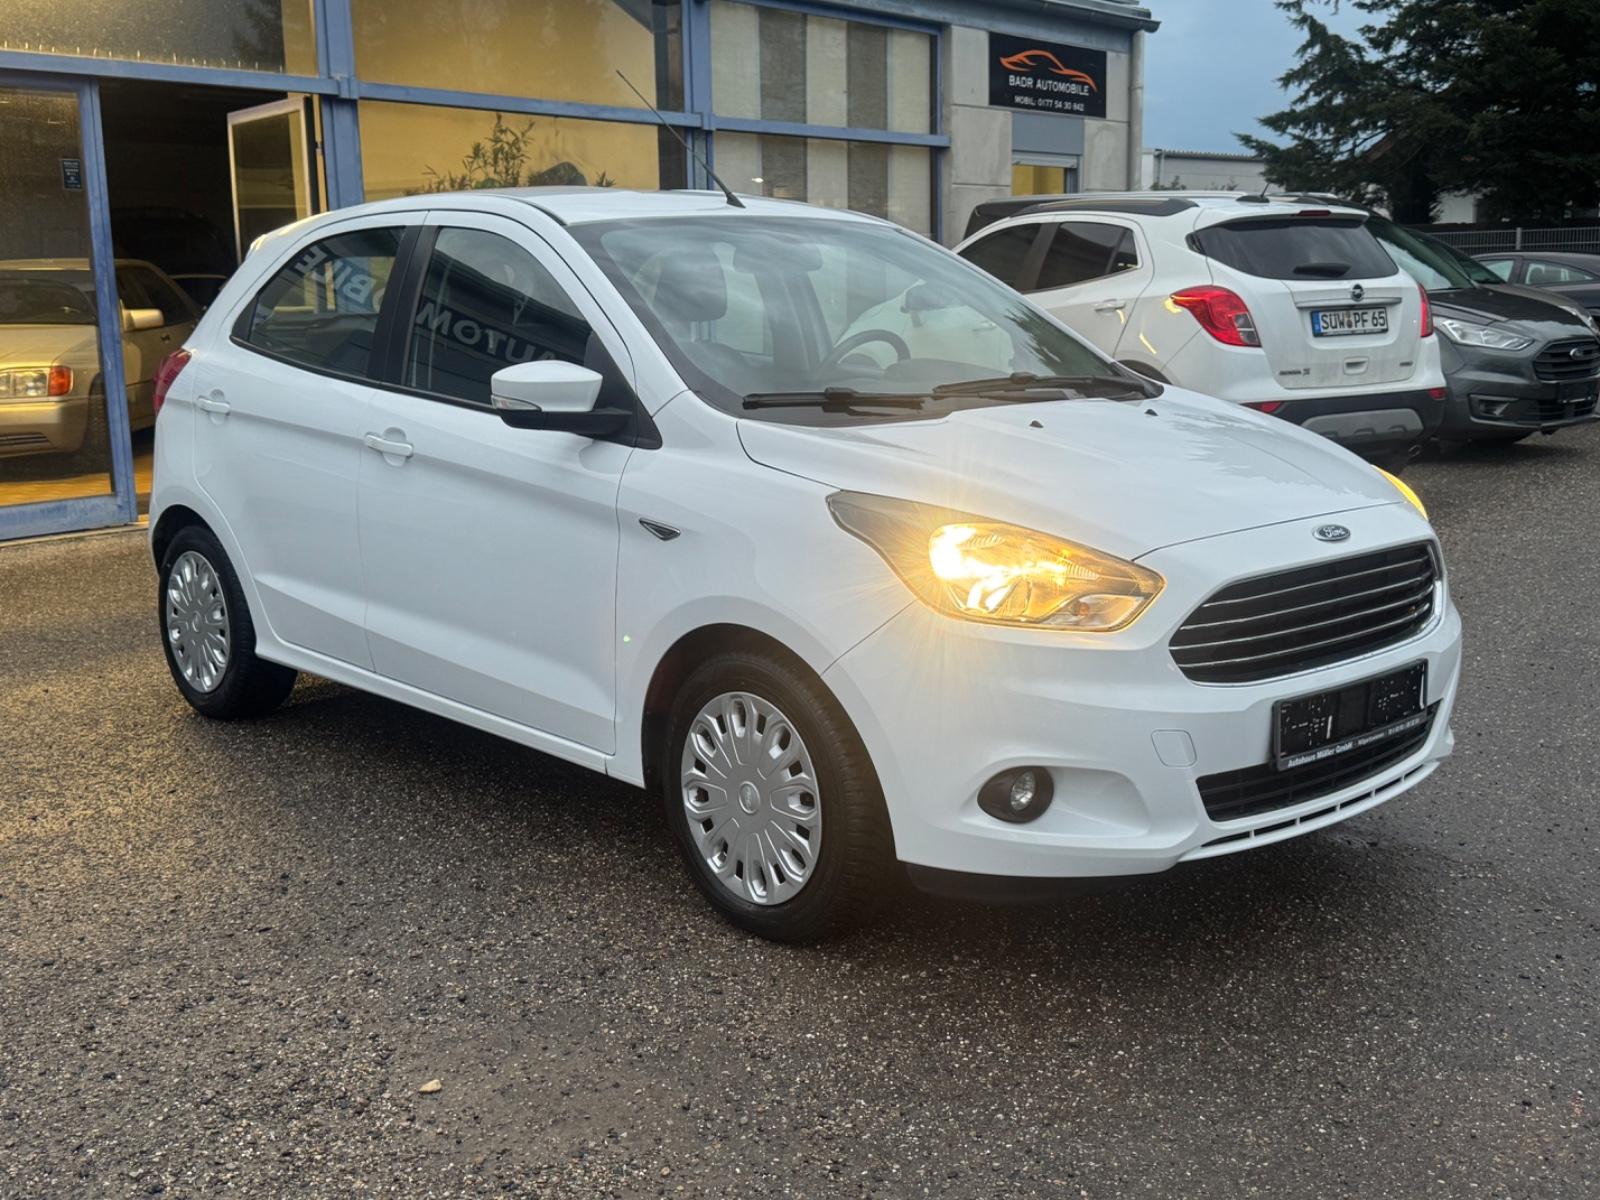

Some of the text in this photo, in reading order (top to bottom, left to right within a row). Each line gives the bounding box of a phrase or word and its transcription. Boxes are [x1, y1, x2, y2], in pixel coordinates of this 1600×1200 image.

[1009, 75, 1089, 95] BADR AUTOMOBILE
[1321, 311, 1386, 329] SÜW PF 65
